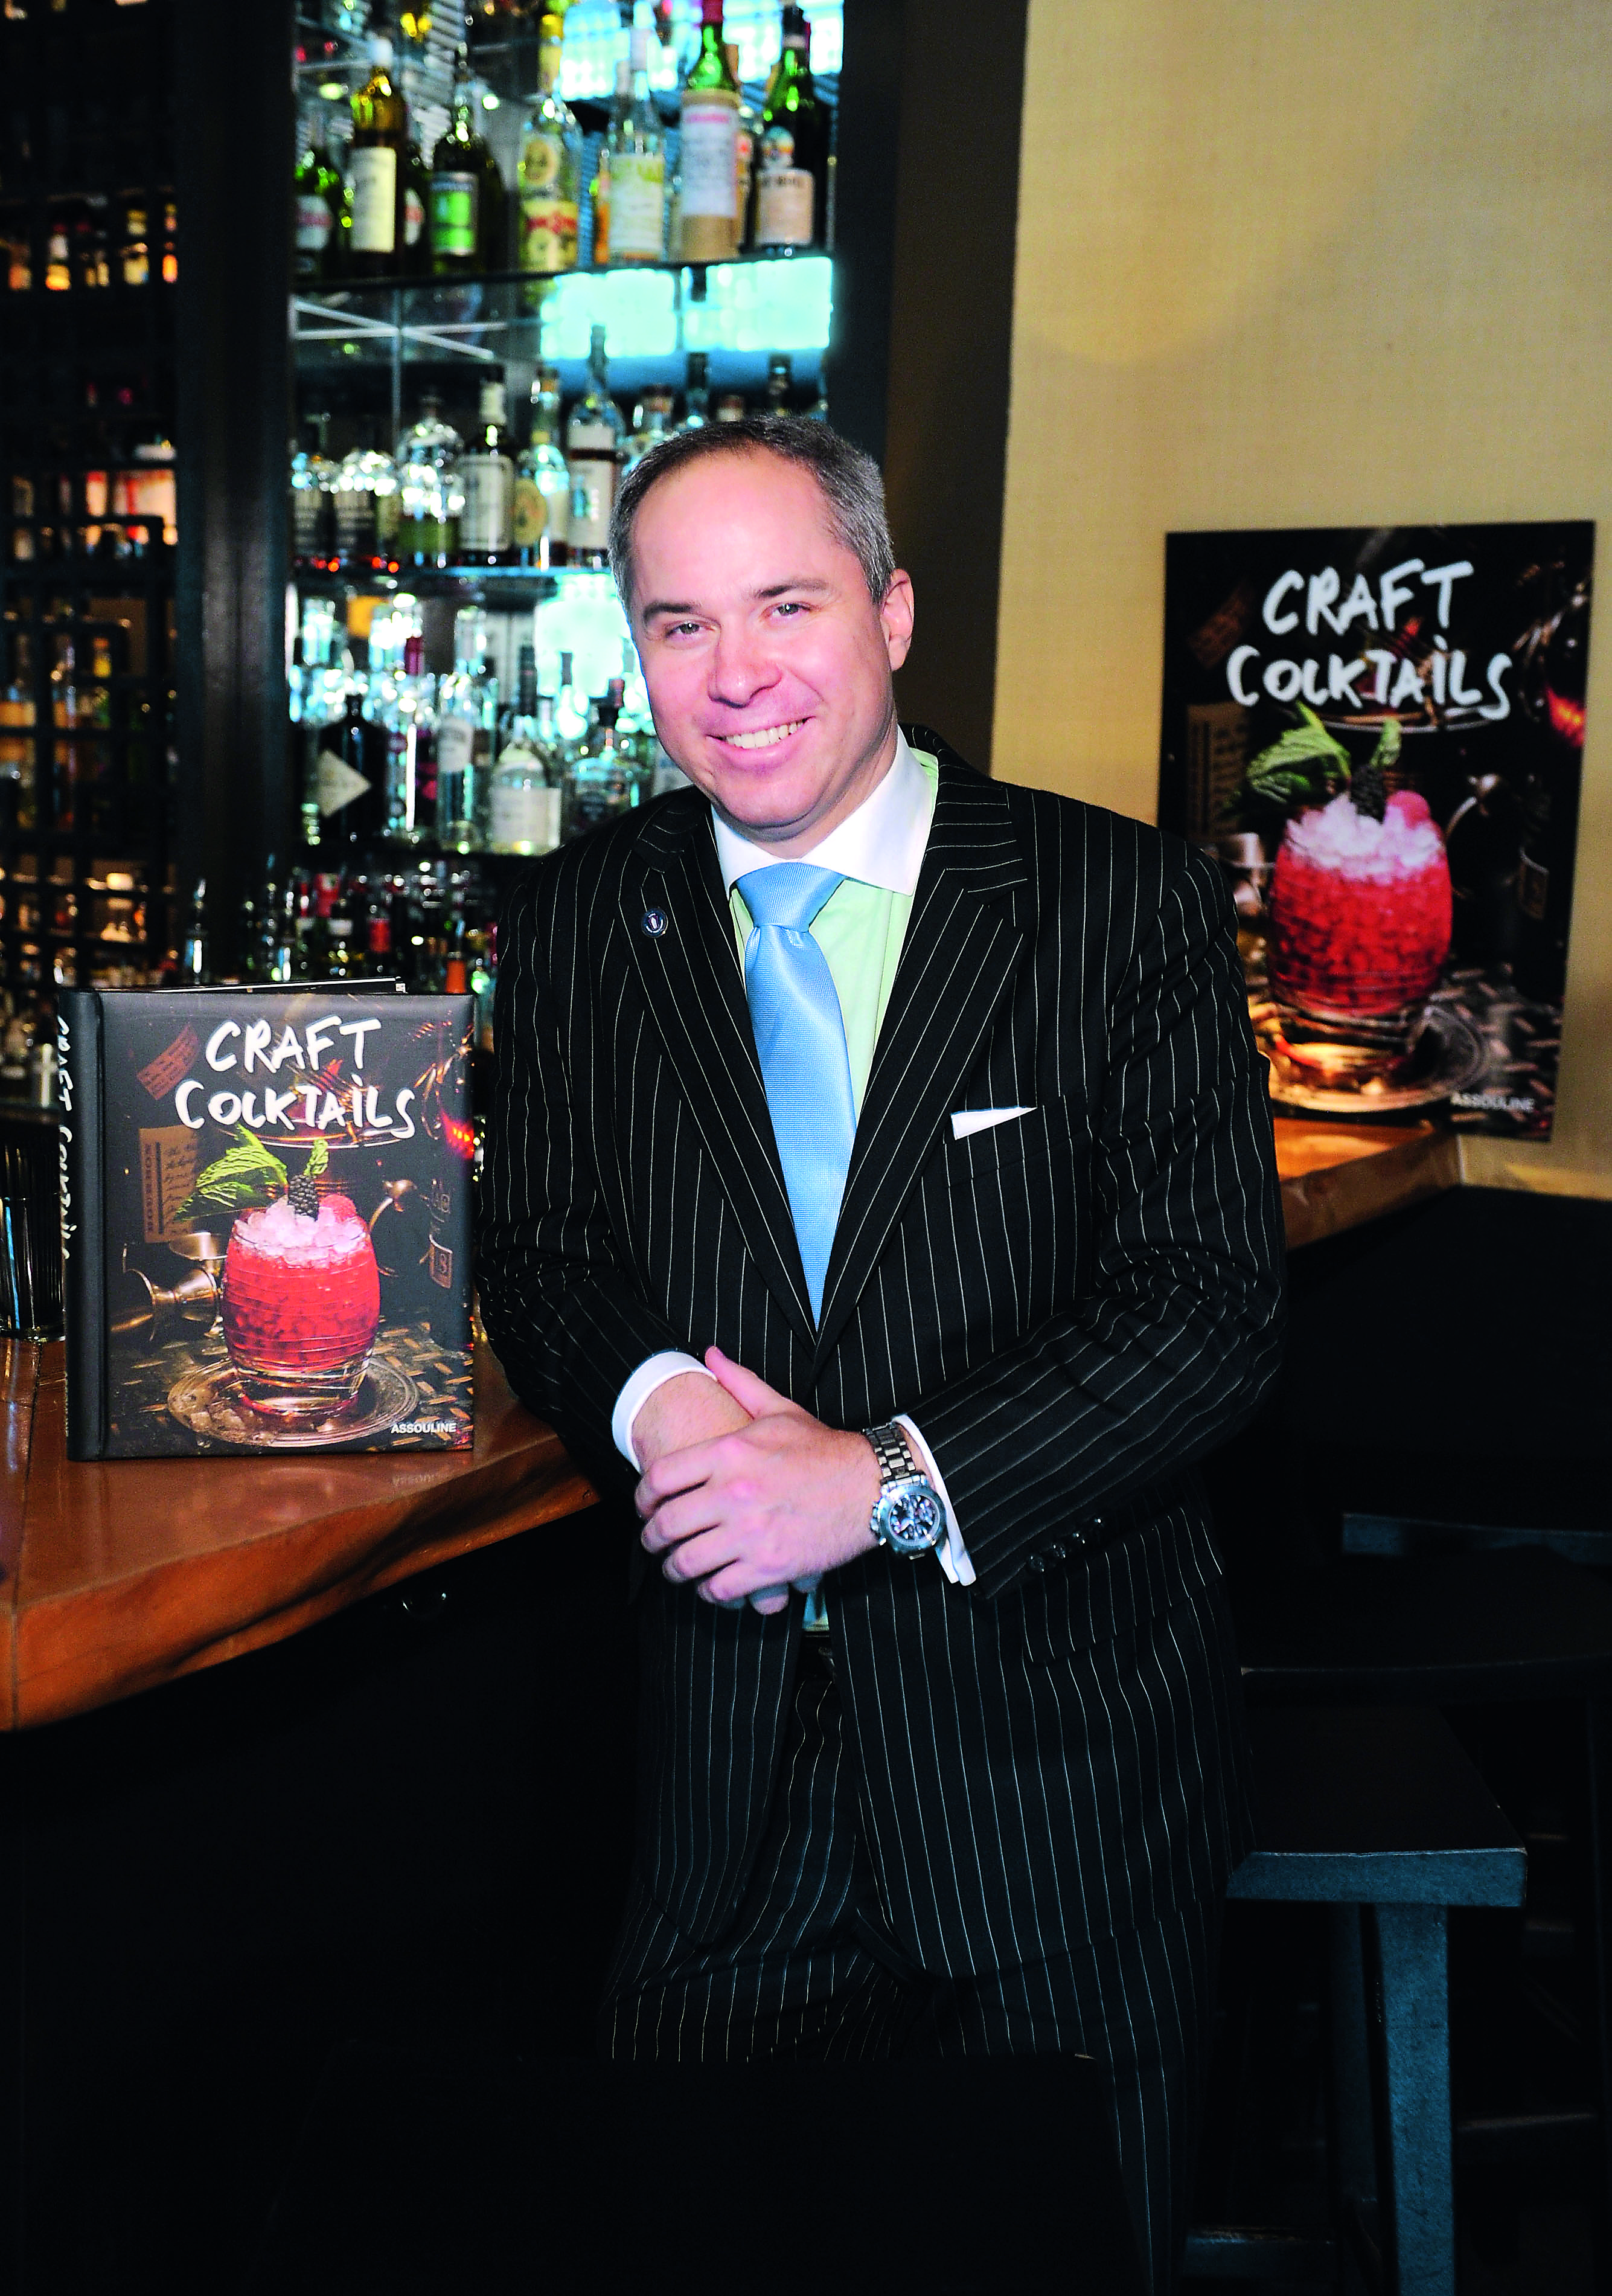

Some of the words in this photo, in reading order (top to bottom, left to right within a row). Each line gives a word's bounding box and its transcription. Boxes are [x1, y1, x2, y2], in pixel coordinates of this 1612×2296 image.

[1262, 557, 1474, 636] CRAFT
[204, 1015, 382, 1074] CRAFT
[391, 1423, 457, 1434] ASSOULINE
